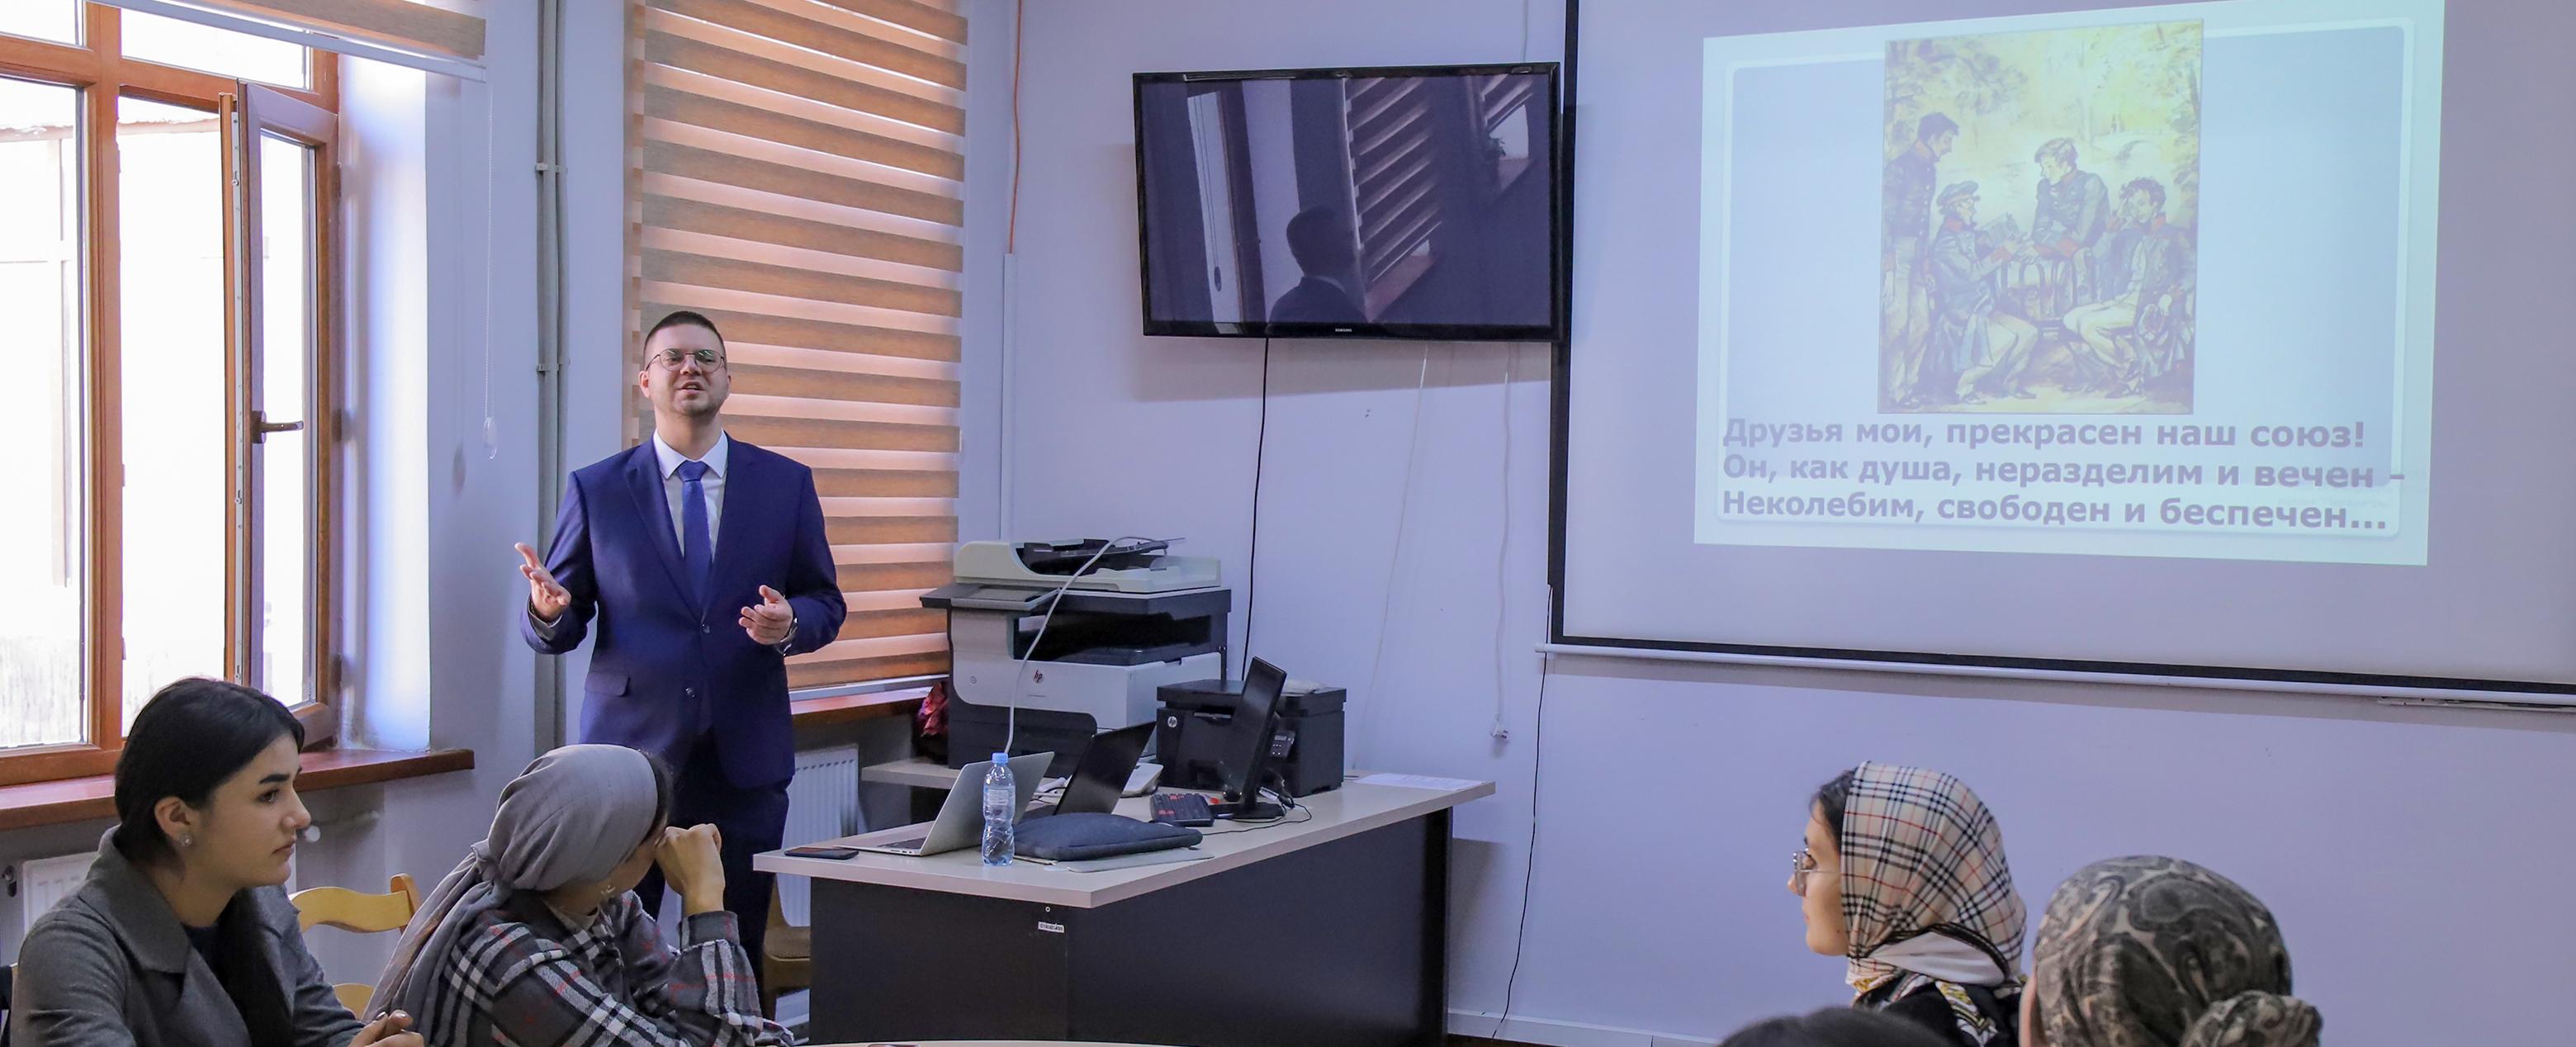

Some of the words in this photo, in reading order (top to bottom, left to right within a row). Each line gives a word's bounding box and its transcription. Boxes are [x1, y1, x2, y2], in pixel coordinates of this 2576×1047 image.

[1722, 418, 1843, 448] Друзья
[1856, 423, 1933, 448] мои,
[1946, 423, 2142, 450] прекрасен
[2157, 424, 2236, 446] наш
[2250, 421, 2364, 448] союз!
[1723, 453, 1777, 484] Он,
[1790, 459, 1849, 480] как
[1858, 460, 1962, 486] душа,
[1976, 462, 2203, 488] неразделим
[2218, 466, 2239, 486] и
[2255, 466, 2373, 488] вечен
[1723, 490, 1925, 524] Неколебим,
[1937, 495, 2110, 525] свободен
[2124, 503, 2145, 523] и
[2160, 498, 2386, 529] беспечен...
